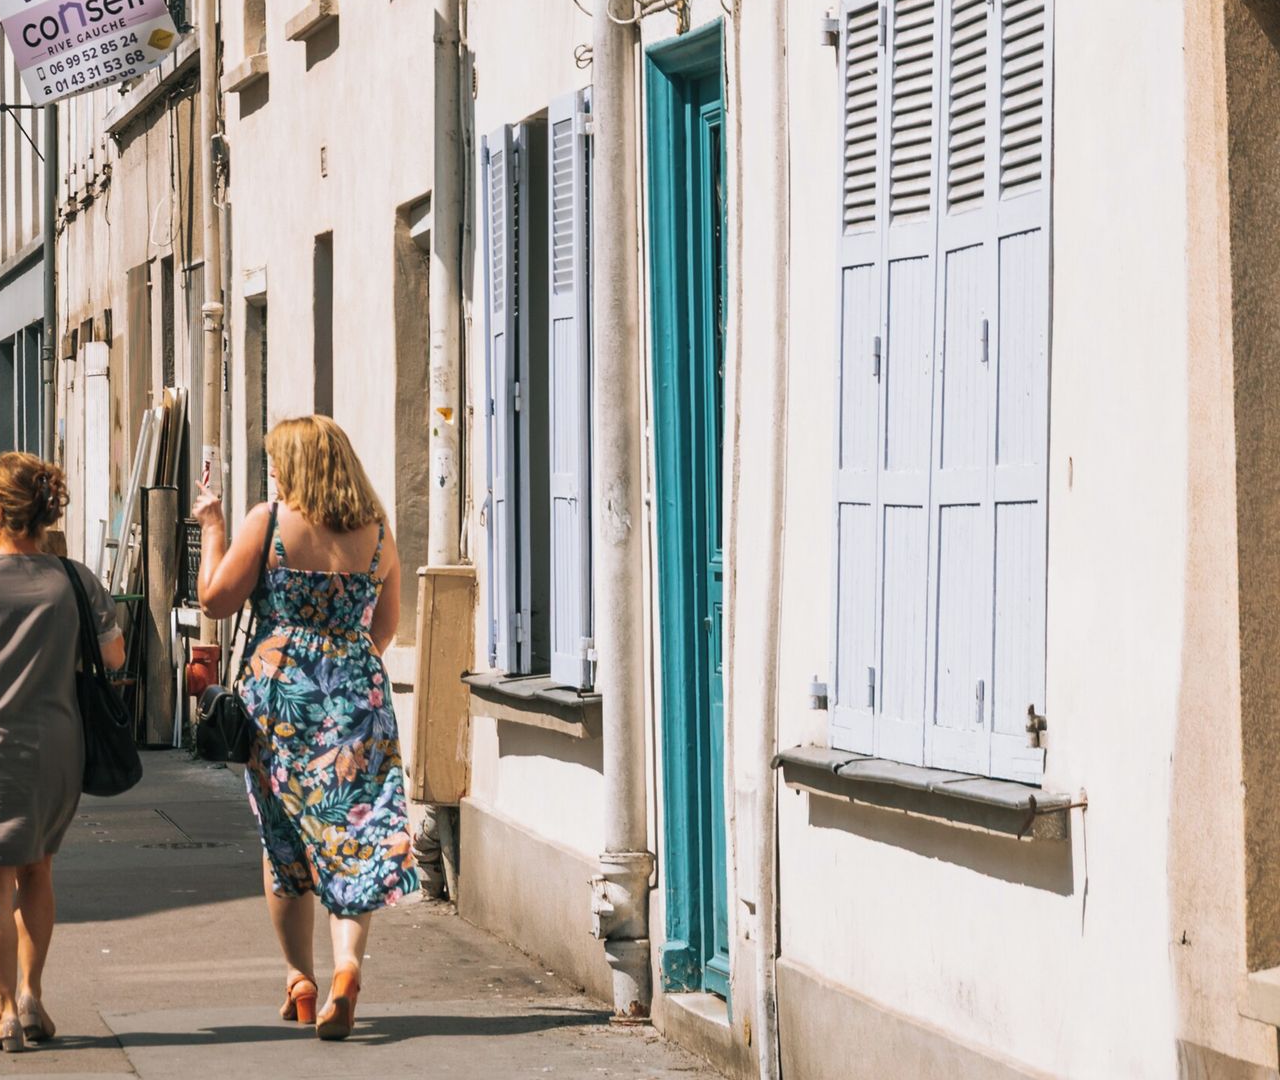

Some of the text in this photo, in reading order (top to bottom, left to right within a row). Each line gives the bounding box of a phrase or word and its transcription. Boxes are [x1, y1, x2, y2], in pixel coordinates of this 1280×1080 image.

[47, 18, 127, 56] RIVE GAUCHE
[49, 32, 138, 76] 06 99 52 85 24
[55, 78, 69, 93] 01
[71, 71, 86, 86] 43
[87, 64, 101, 80] 31
[103, 57, 123, 73] 53
[125, 49, 145, 65] 68
